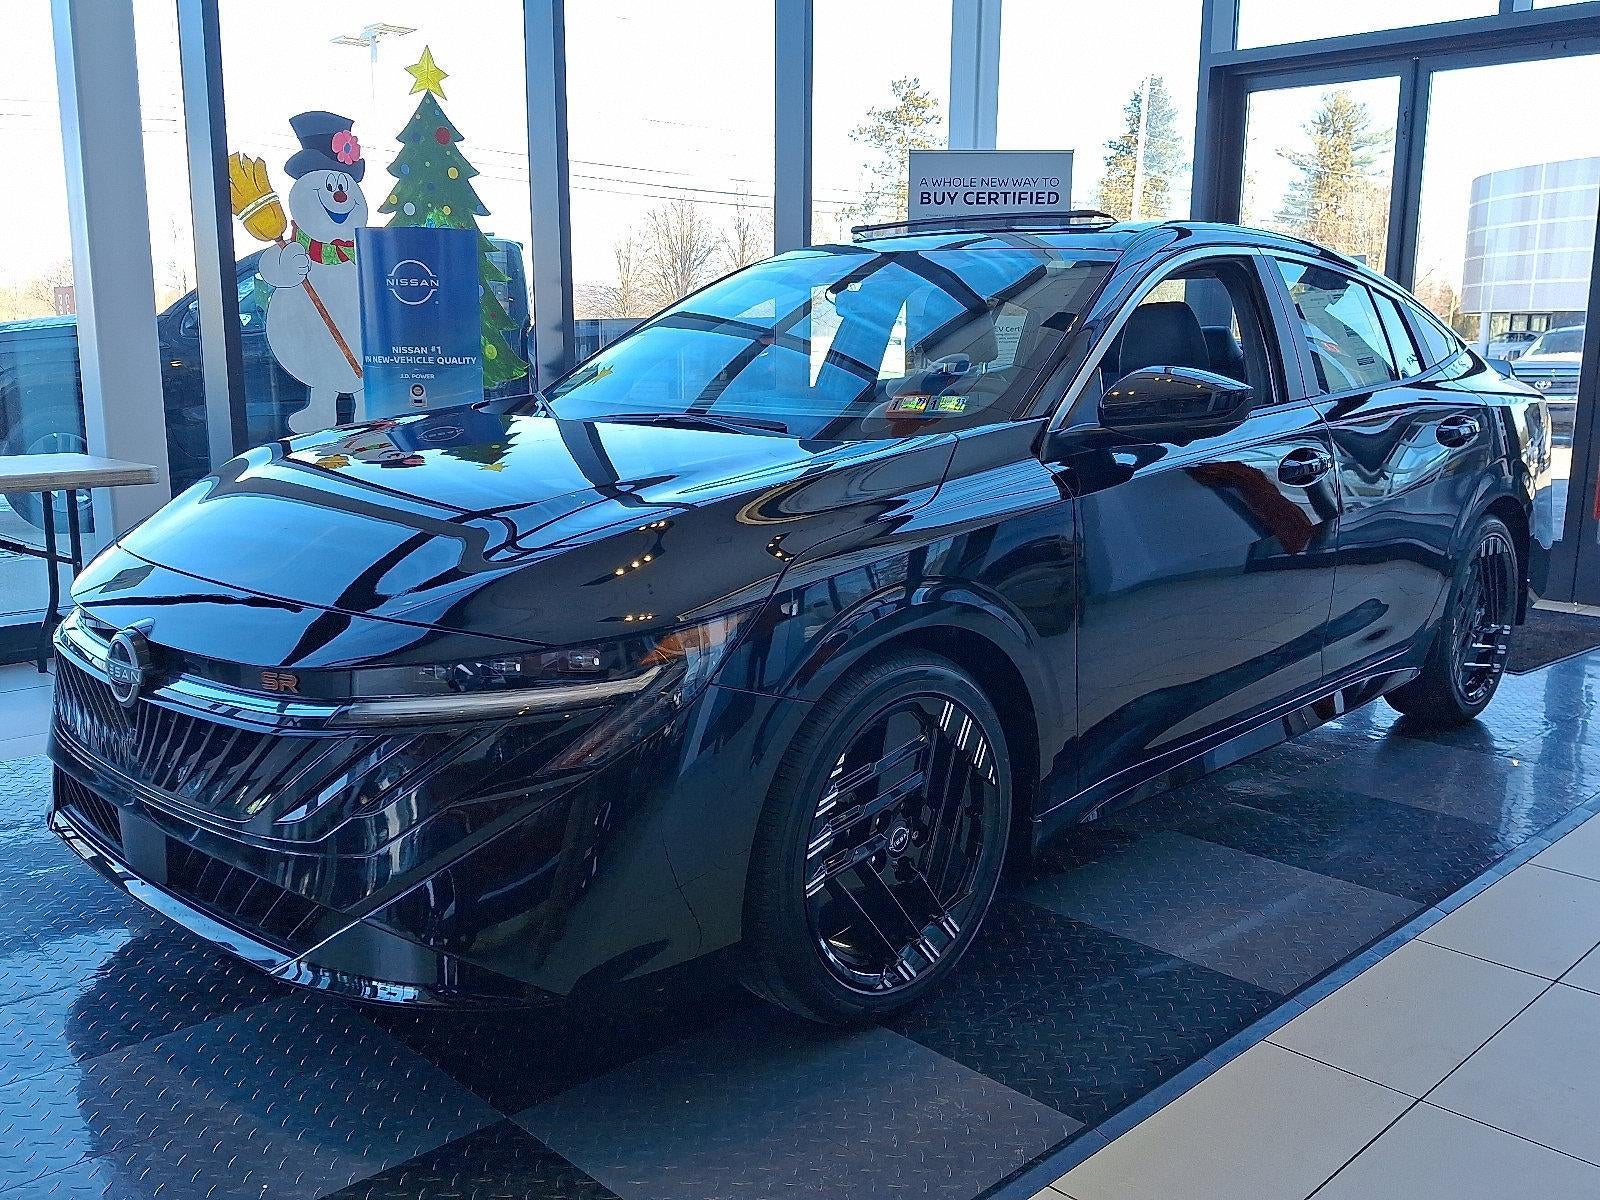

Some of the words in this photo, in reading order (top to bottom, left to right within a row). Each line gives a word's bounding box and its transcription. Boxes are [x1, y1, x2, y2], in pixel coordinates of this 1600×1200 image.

[919, 177, 928, 187] A
[932, 177, 977, 187] WHOLE
[981, 177, 1009, 187] NEW
[1012, 177, 1038, 187] WAY
[1042, 177, 1059, 187] TO
[920, 191, 958, 205] BUY
[963, 191, 1060, 205] CERTIFIED
[386, 278, 439, 287] NISSAN
[1005, 325, 1023, 333] Cert
[392, 346, 428, 354] NISSAN
[431, 346, 442, 355] #1
[365, 355, 372, 363] IN
[373, 356, 435, 364] NEW-VEHICLE
[437, 356, 477, 365] QUALITY
[109, 664, 141, 683] SSAN
[261, 671, 299, 694] SR
